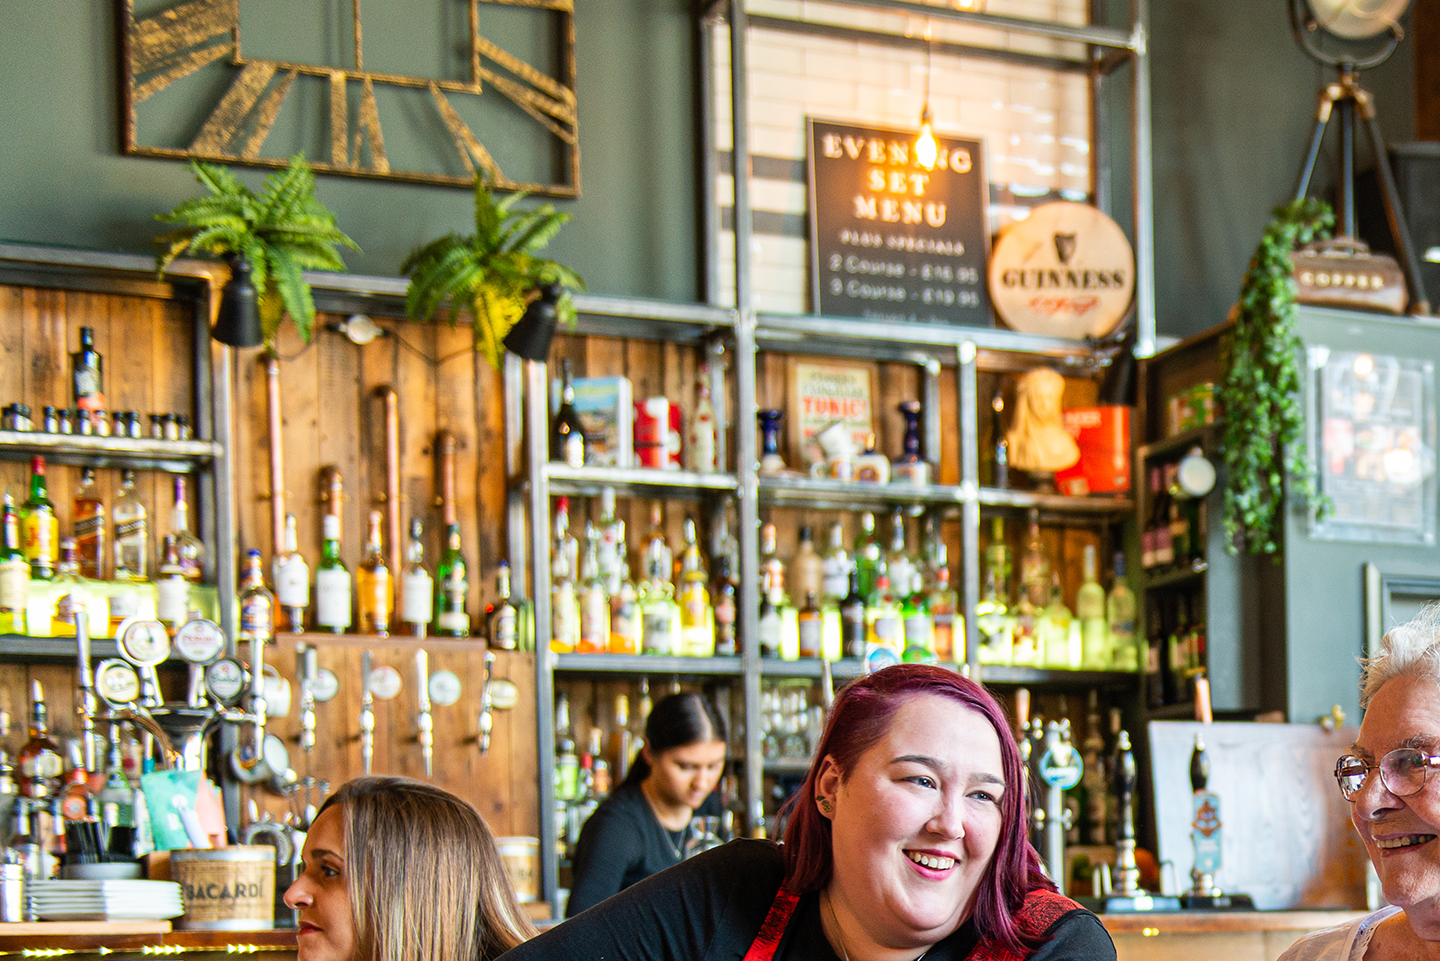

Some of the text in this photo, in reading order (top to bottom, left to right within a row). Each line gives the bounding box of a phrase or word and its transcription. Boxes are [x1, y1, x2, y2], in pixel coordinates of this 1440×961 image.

[823, 132, 972, 174] EVENNG
[867, 167, 931, 197] SET
[853, 193, 948, 228] MENU
[841, 229, 966, 257] PLUS SPECIALS
[830, 253, 843, 272] 2
[845, 255, 906, 278] Course
[1002, 268, 1125, 290] GUINNESS
[830, 277, 843, 296] 3
[846, 279, 907, 303] Course
